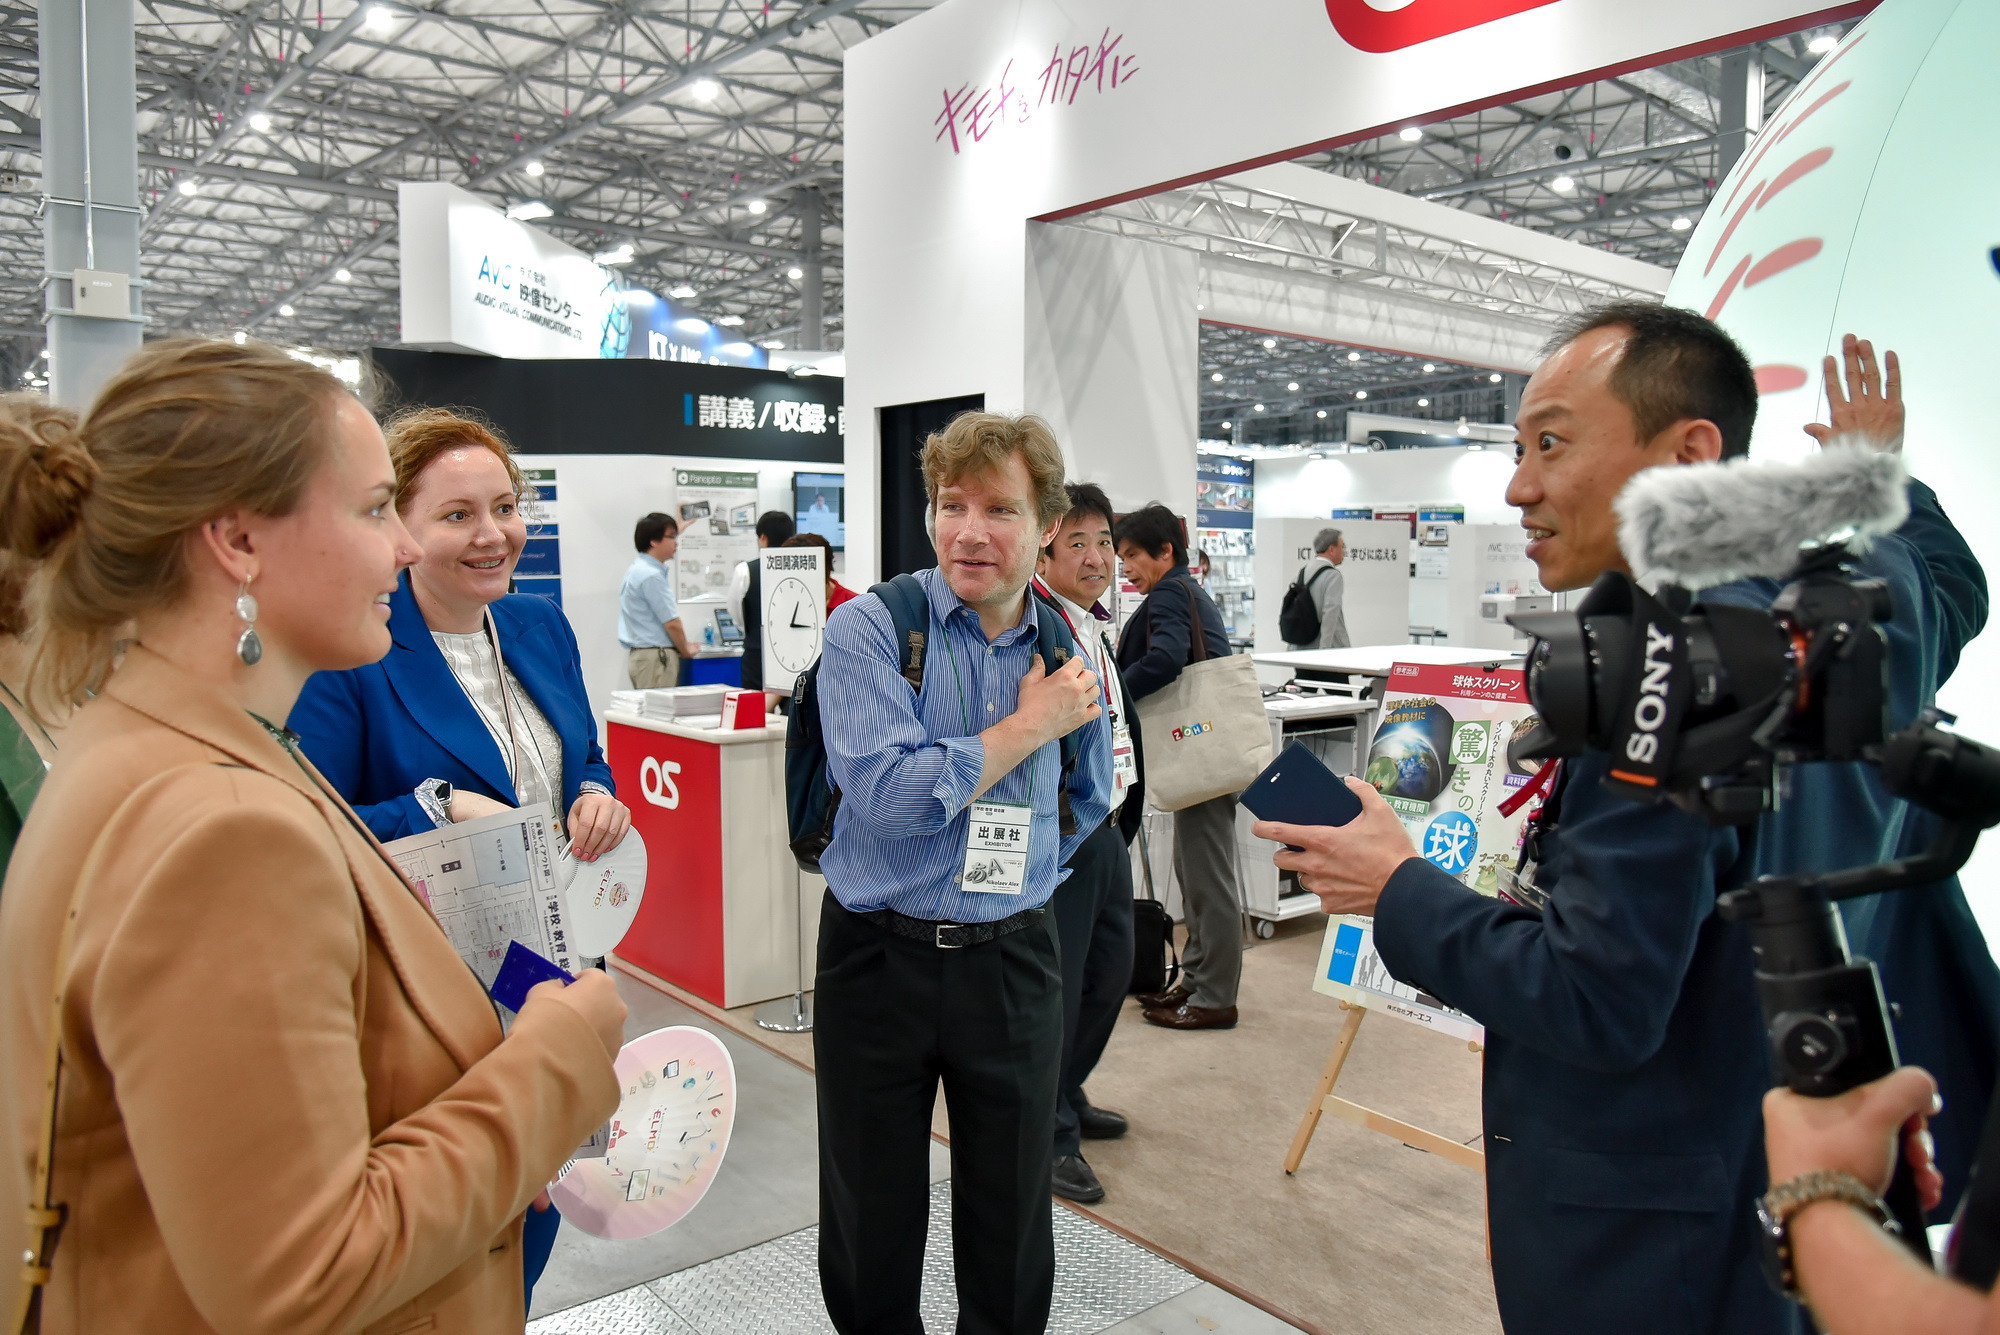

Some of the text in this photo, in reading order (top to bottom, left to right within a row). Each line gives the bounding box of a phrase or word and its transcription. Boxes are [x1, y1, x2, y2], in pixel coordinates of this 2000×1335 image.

[698, 394, 845, 435] 講義/収録・
[1297, 548, 1311, 560] ICT
[1452, 674, 1521, 691] 球体スクリーン
[1626, 621, 1674, 764] SONY
[1386, 697, 1437, 711] 理科や社会の
[1385, 711, 1426, 724] 映像教材に
[1173, 722, 1212, 741] ZOHO
[978, 826, 1020, 841] 出展社
[593, 868, 611, 906] ELMO
[547, 901, 567, 953] 学校・教育
[647, 1109, 662, 1151] ELMO
